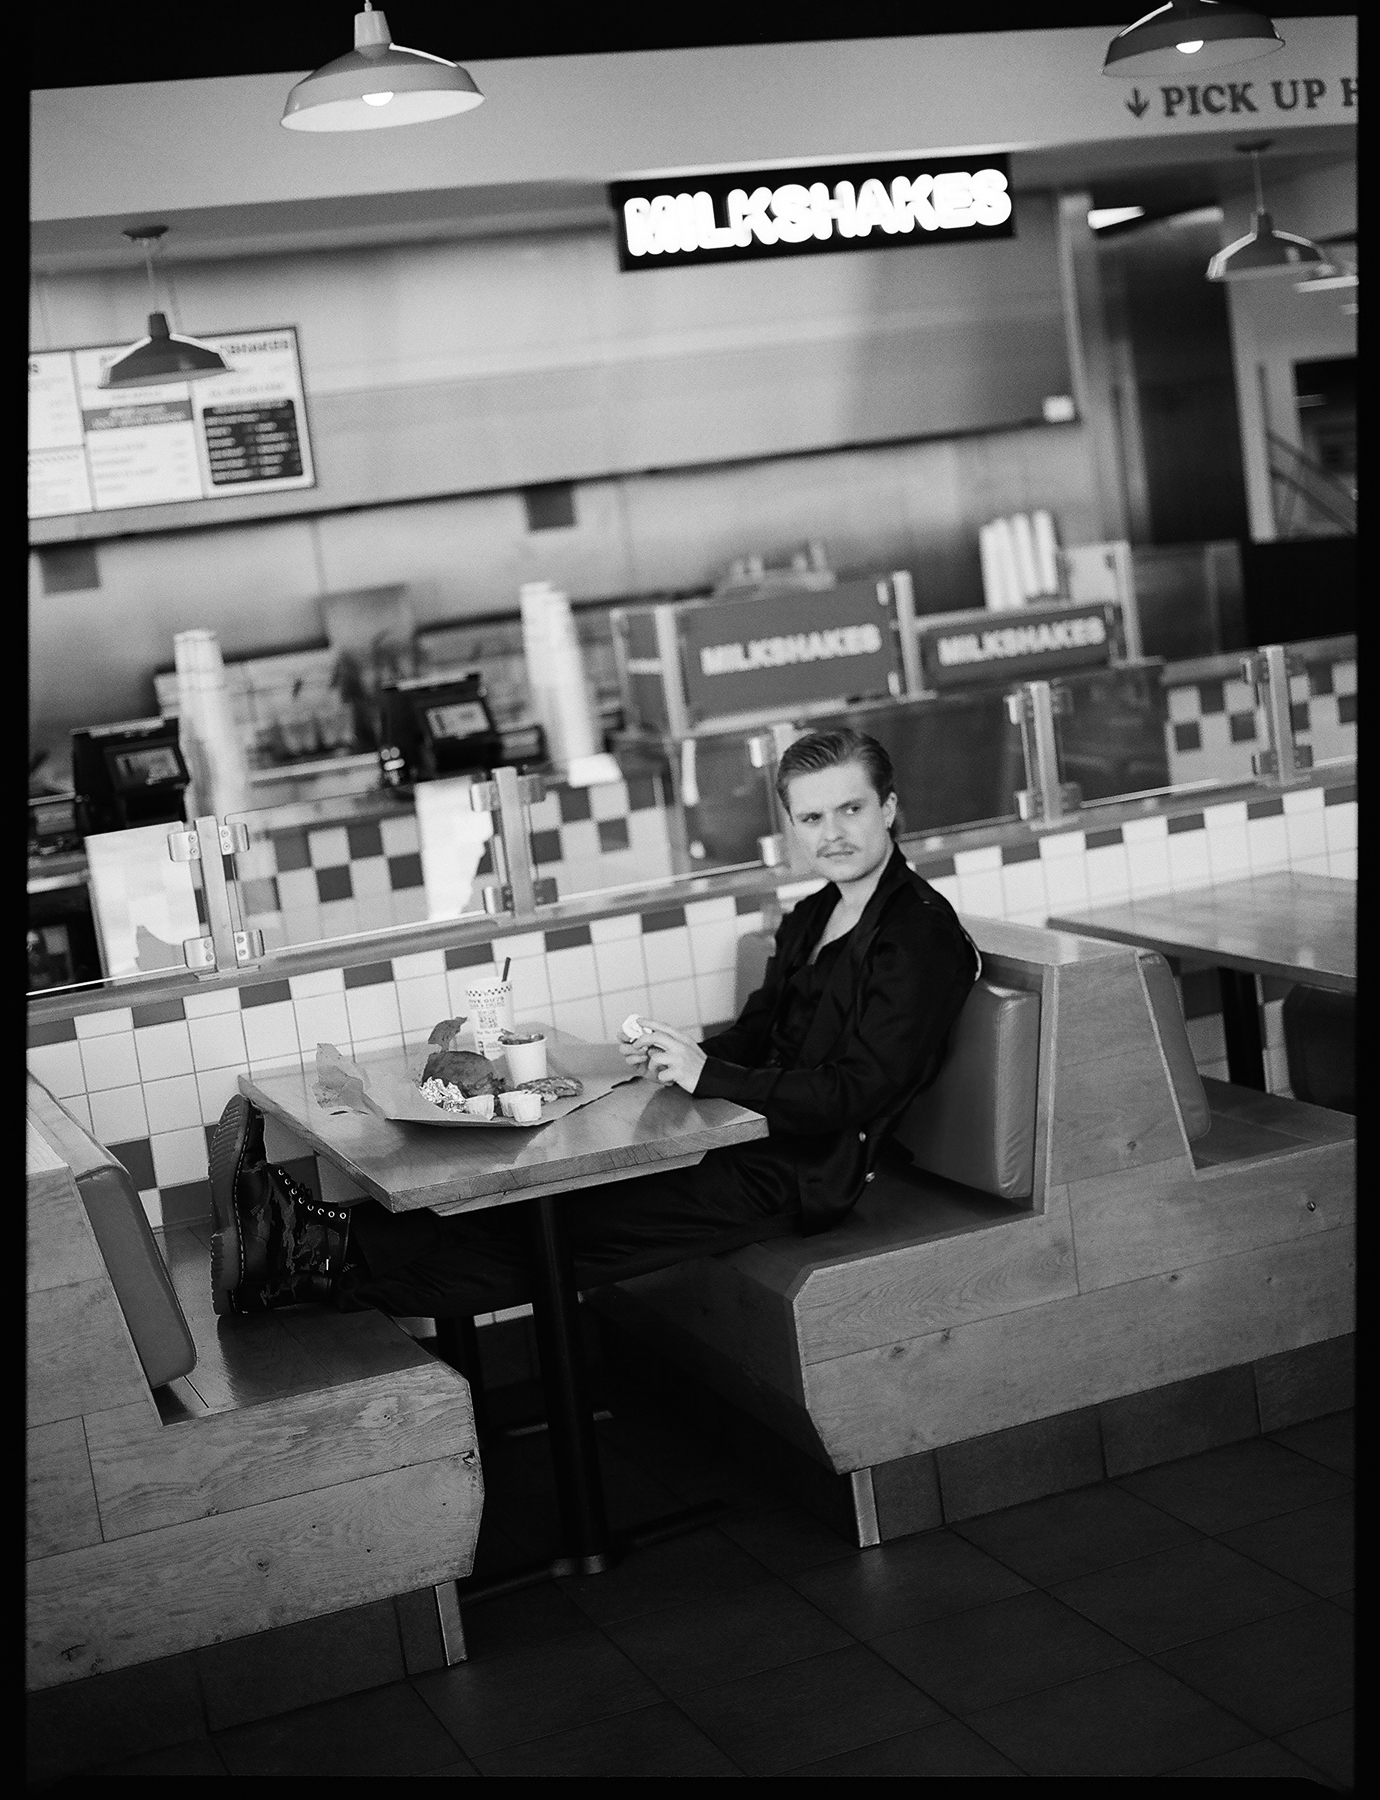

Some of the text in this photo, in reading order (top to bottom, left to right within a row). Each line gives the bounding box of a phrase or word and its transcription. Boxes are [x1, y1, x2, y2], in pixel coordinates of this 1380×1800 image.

[1161, 82, 1258, 117] PICK
[1271, 77, 1326, 110] UP
[624, 168, 1012, 257] MILKSHAKES
[701, 623, 882, 676] MILKSHAKES
[936, 615, 1107, 667] MILKSHAKES
